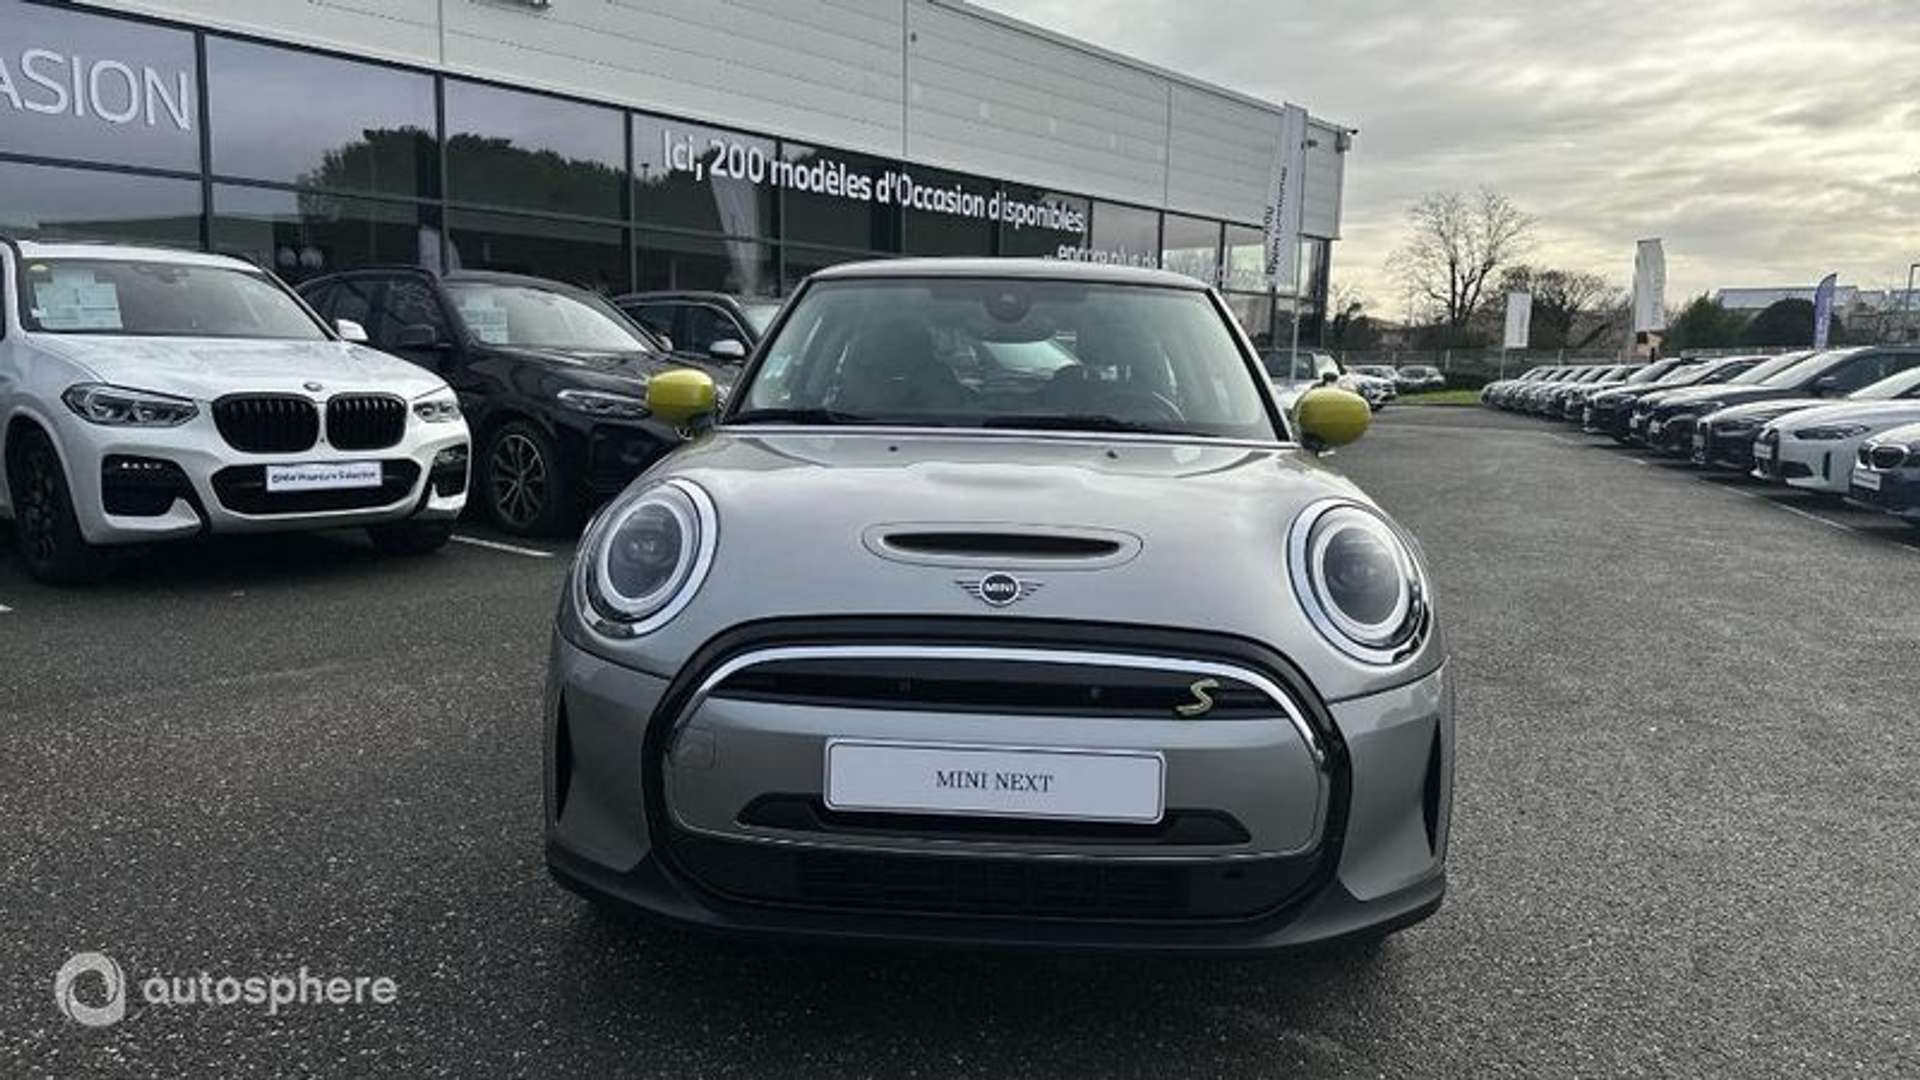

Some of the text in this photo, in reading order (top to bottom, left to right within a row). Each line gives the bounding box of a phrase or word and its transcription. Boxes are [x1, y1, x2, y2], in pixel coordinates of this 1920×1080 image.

[664, 130, 702, 182] Ici,
[709, 139, 764, 184] 200
[769, 158, 872, 201] modèles
[875, 171, 985, 219] d'Occasion
[984, 582, 1016, 593] MINI
[1176, 678, 1219, 716] S
[935, 770, 1055, 792] MINI NEXT
